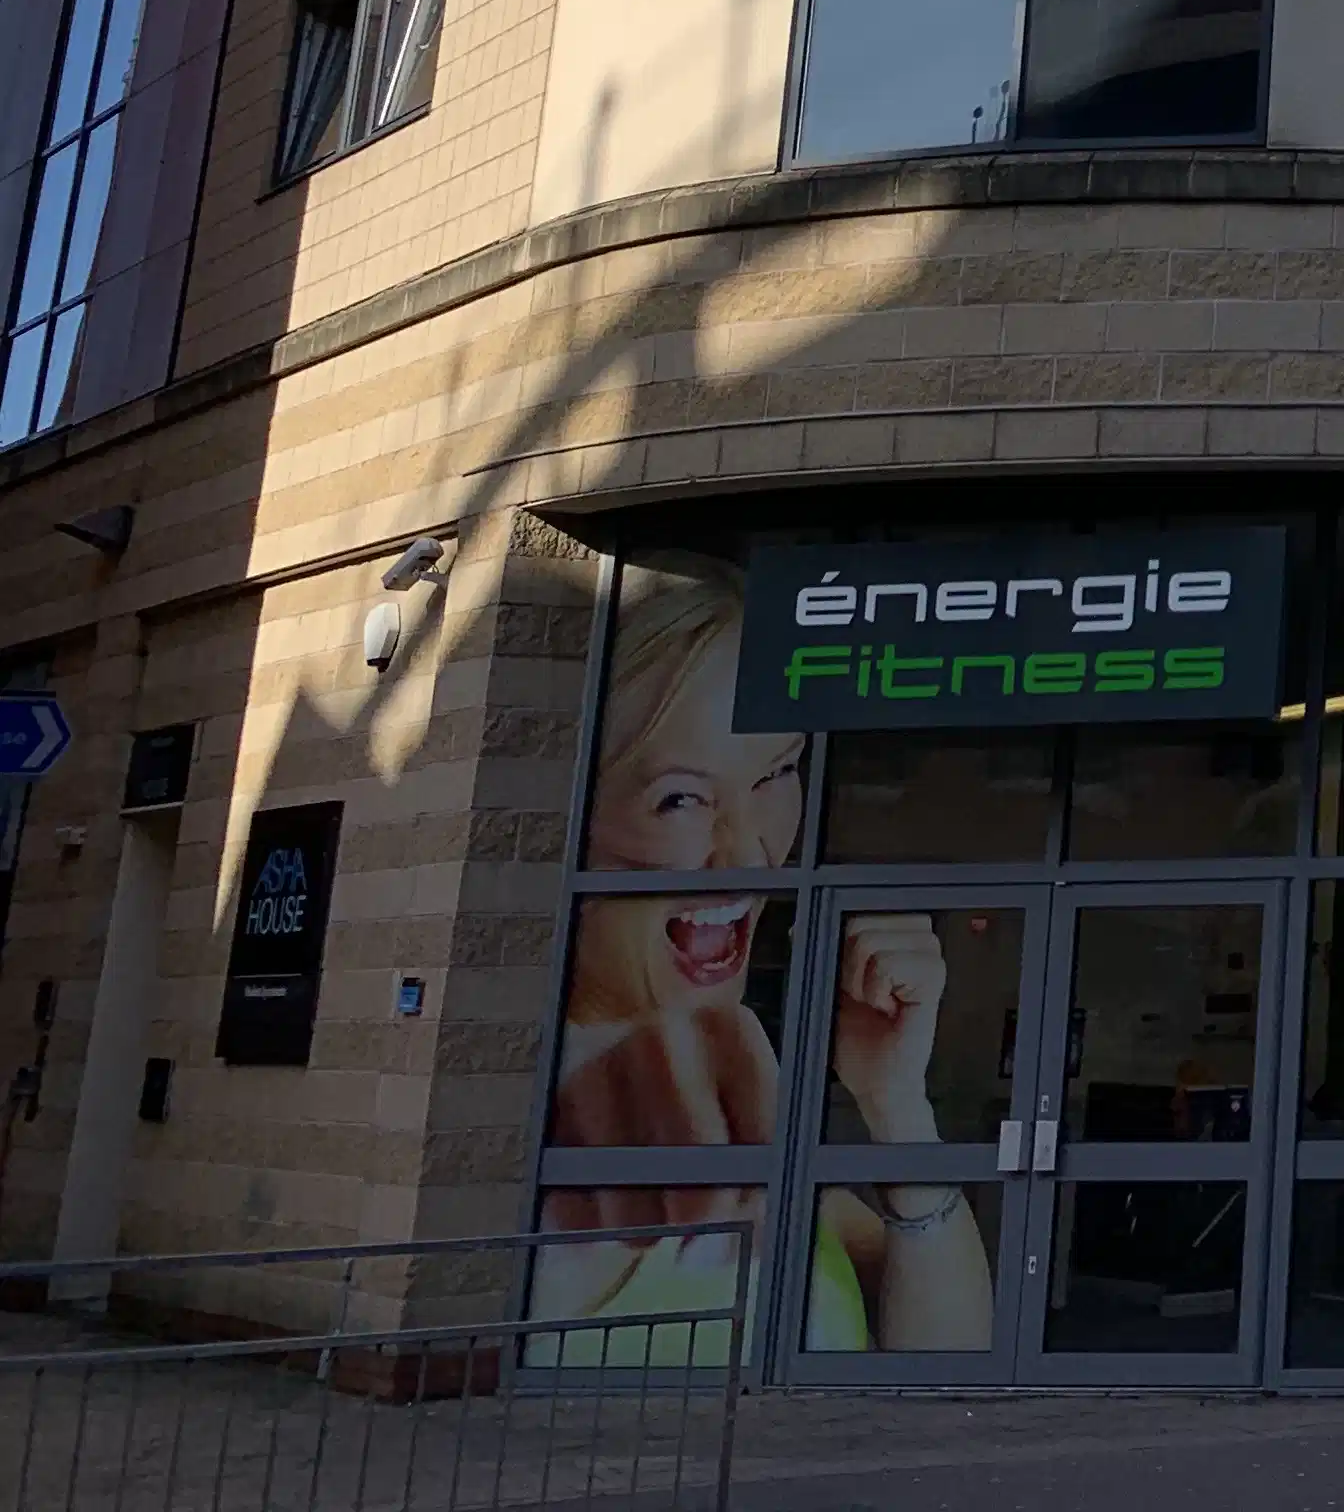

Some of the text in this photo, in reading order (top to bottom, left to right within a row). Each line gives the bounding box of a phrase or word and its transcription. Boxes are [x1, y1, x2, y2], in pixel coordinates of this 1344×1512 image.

[796, 559, 1232, 632] énergie
[252, 847, 307, 895] ASHA
[246, 895, 307, 935] HOUSE
